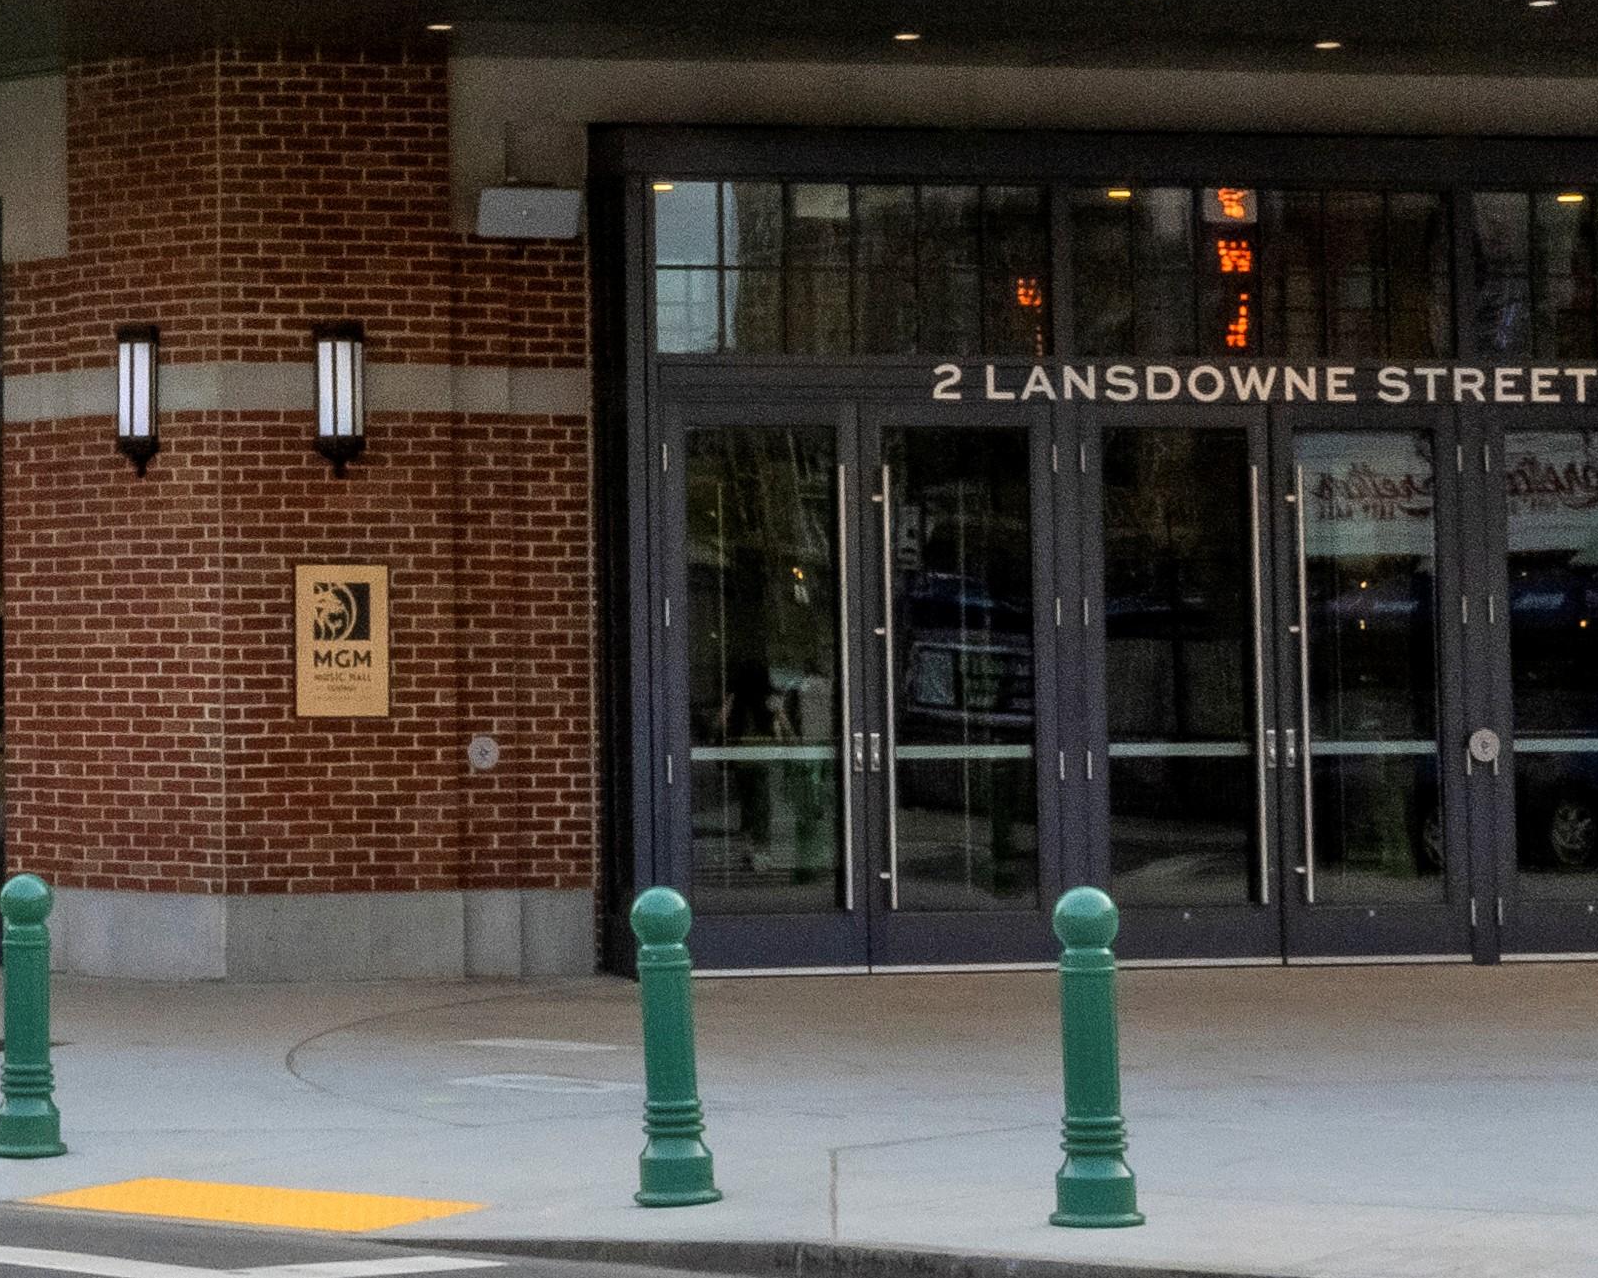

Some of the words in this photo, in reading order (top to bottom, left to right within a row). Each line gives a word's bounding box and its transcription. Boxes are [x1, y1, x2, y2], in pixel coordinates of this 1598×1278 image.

[932, 363, 963, 401] 2
[985, 364, 1358, 403] LANSDOWNE
[1377, 366, 1598, 405] STREET
[313, 649, 372, 668] MGM
